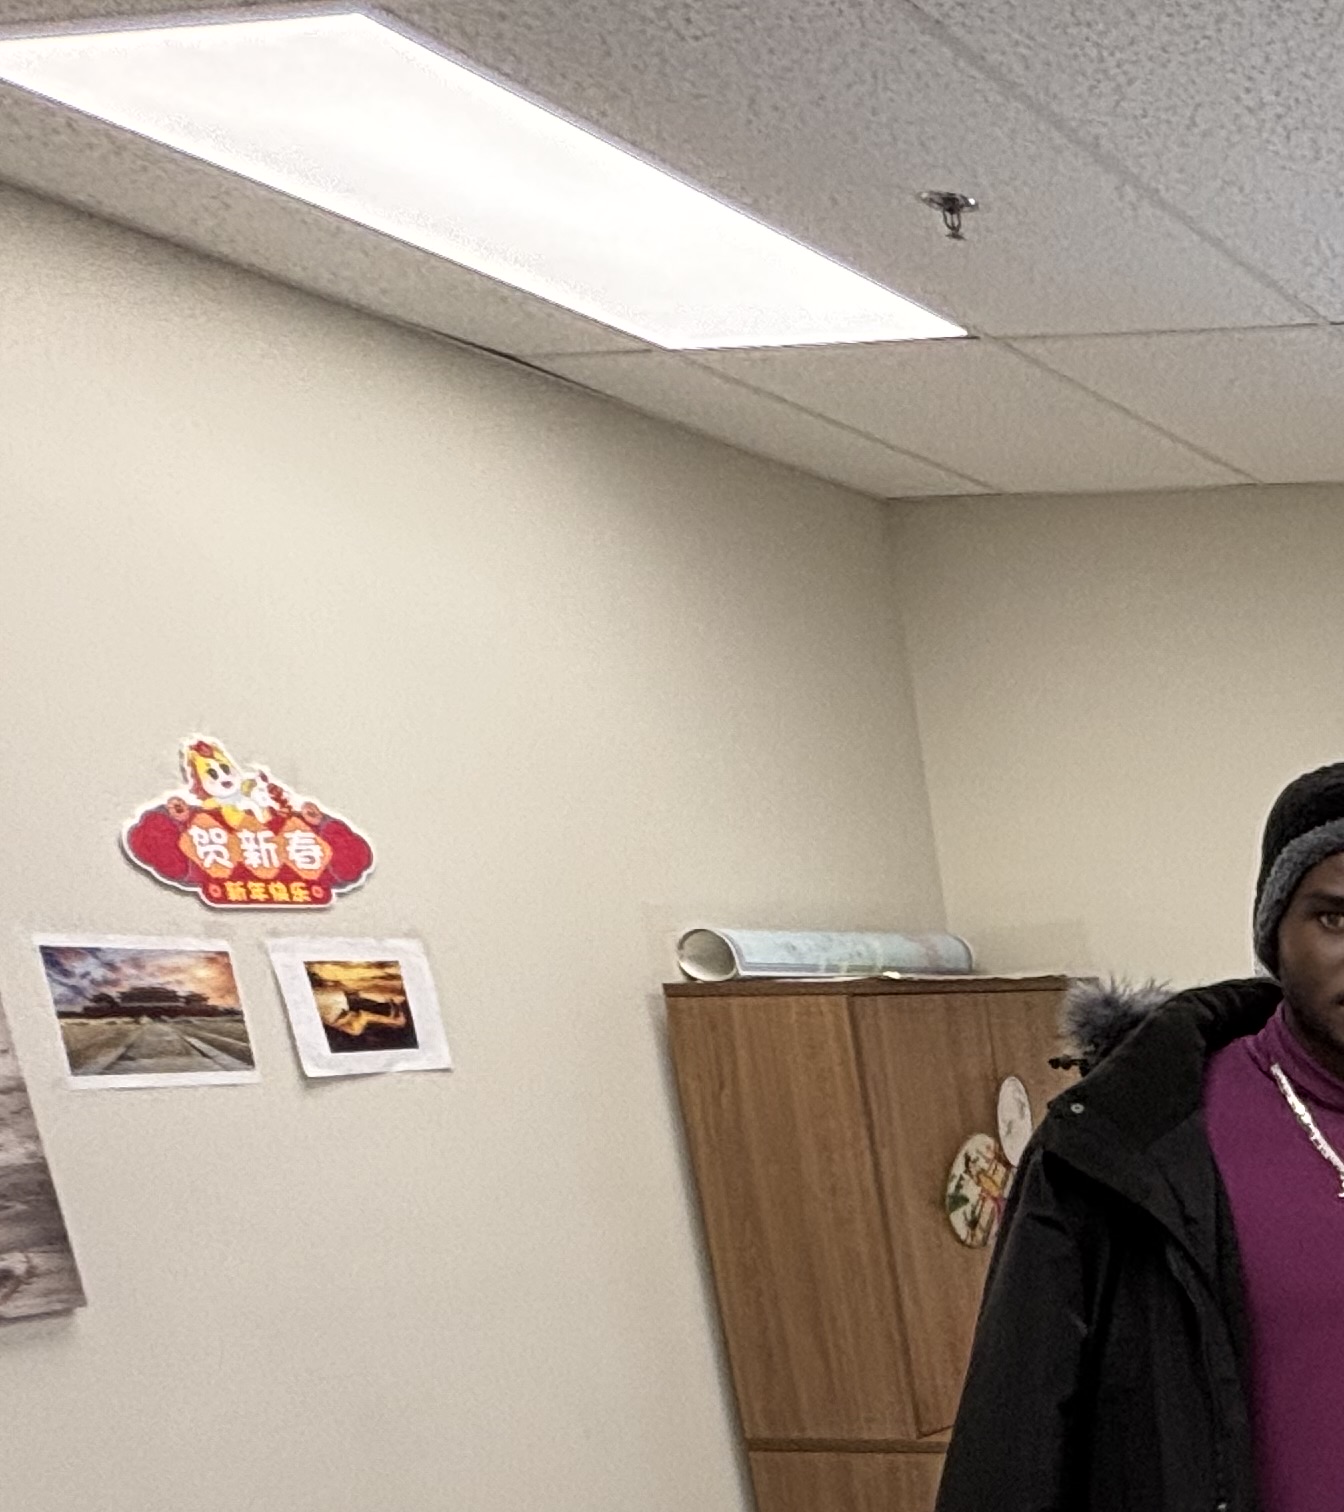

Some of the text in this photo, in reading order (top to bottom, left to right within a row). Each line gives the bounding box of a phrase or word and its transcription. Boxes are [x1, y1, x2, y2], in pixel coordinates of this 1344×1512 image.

[188, 825, 323, 869] 贺新春
[224, 880, 312, 902] 新年快乐
